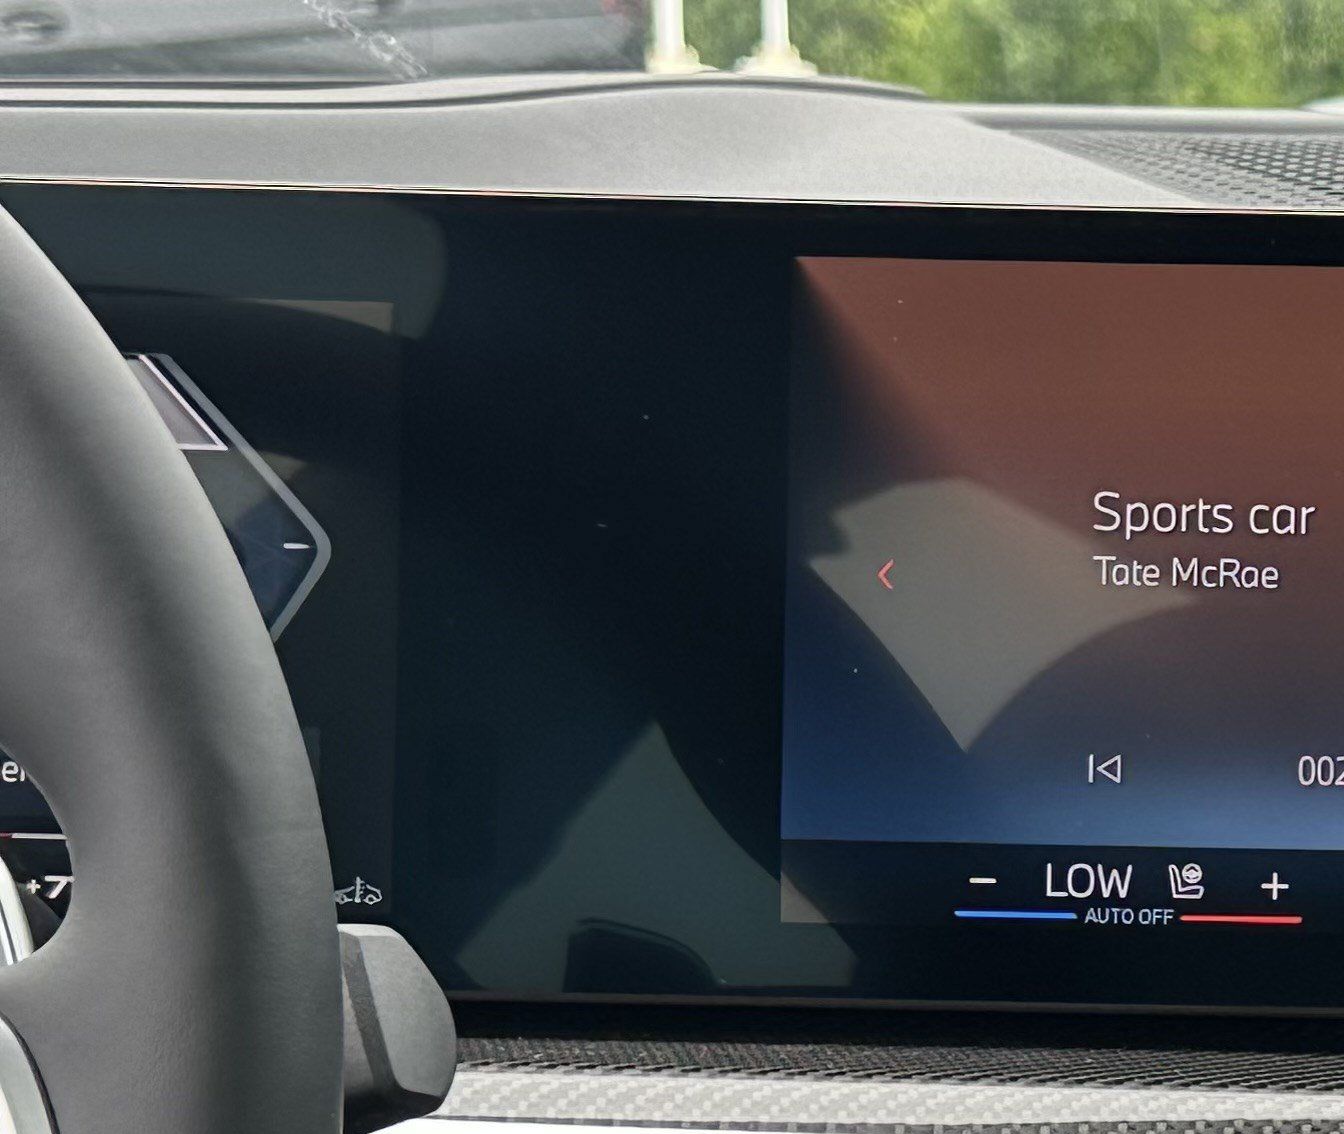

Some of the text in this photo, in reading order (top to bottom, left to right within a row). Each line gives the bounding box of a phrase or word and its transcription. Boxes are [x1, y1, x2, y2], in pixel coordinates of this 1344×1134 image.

[1092, 490, 1316, 541] Sports car
[1092, 554, 1280, 589] Tate McRae
[1044, 862, 1133, 899] LOW
[1083, 907, 1174, 926] AUTO OFF
